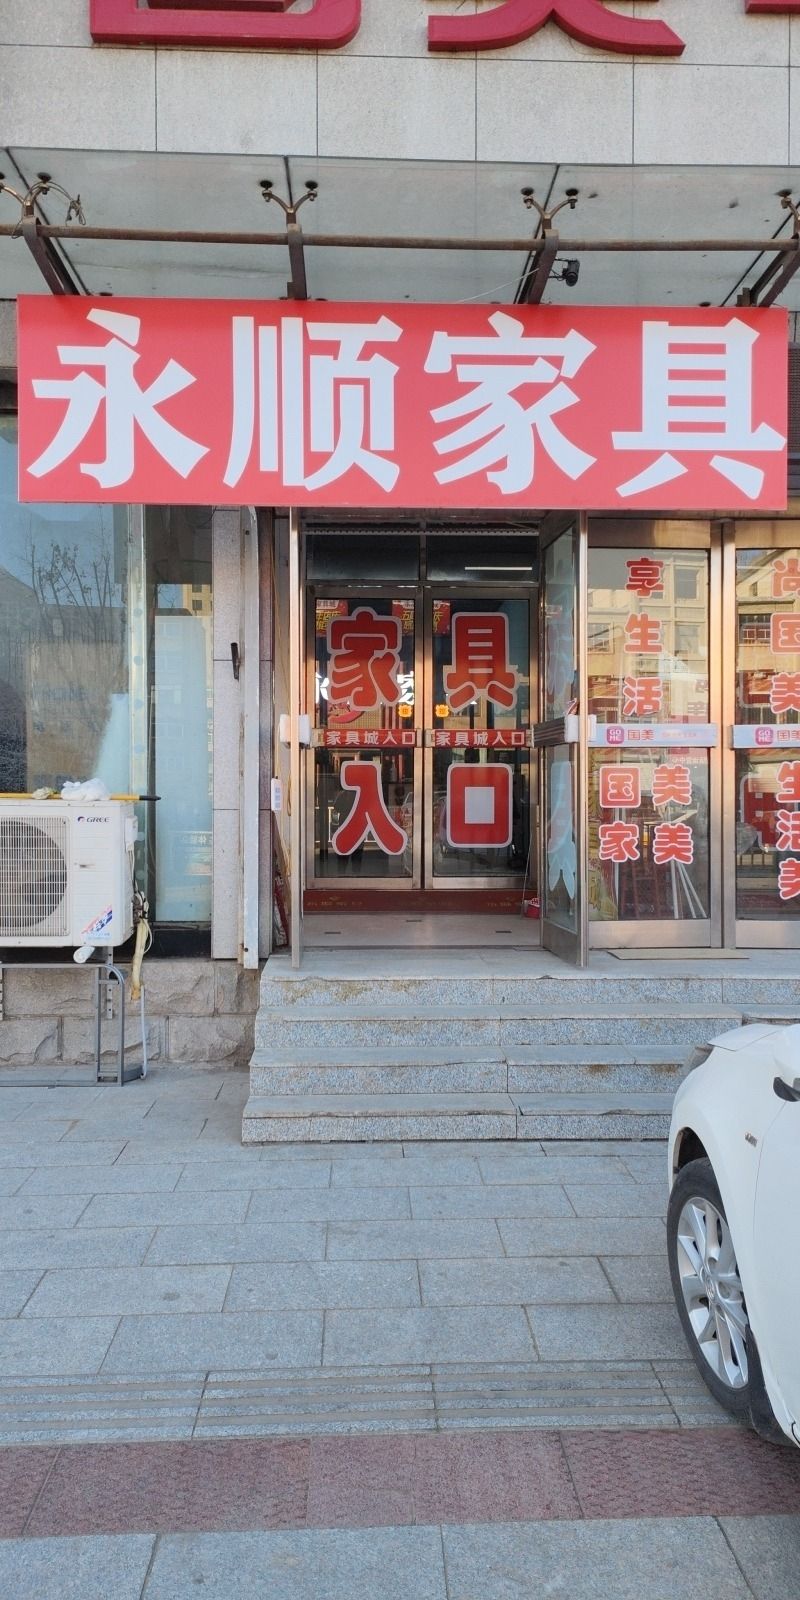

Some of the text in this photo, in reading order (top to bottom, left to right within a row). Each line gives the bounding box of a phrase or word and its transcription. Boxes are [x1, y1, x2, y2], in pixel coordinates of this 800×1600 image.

[27, 308, 787, 499] 永顺家具
[326, 607, 518, 713] 家具
[622, 557, 664, 717] 享生活
[326, 731, 416, 745] 家具城入口
[436, 731, 525, 746] 家具城入口
[627, 729, 654, 741] 国美
[332, 761, 514, 855] 入口
